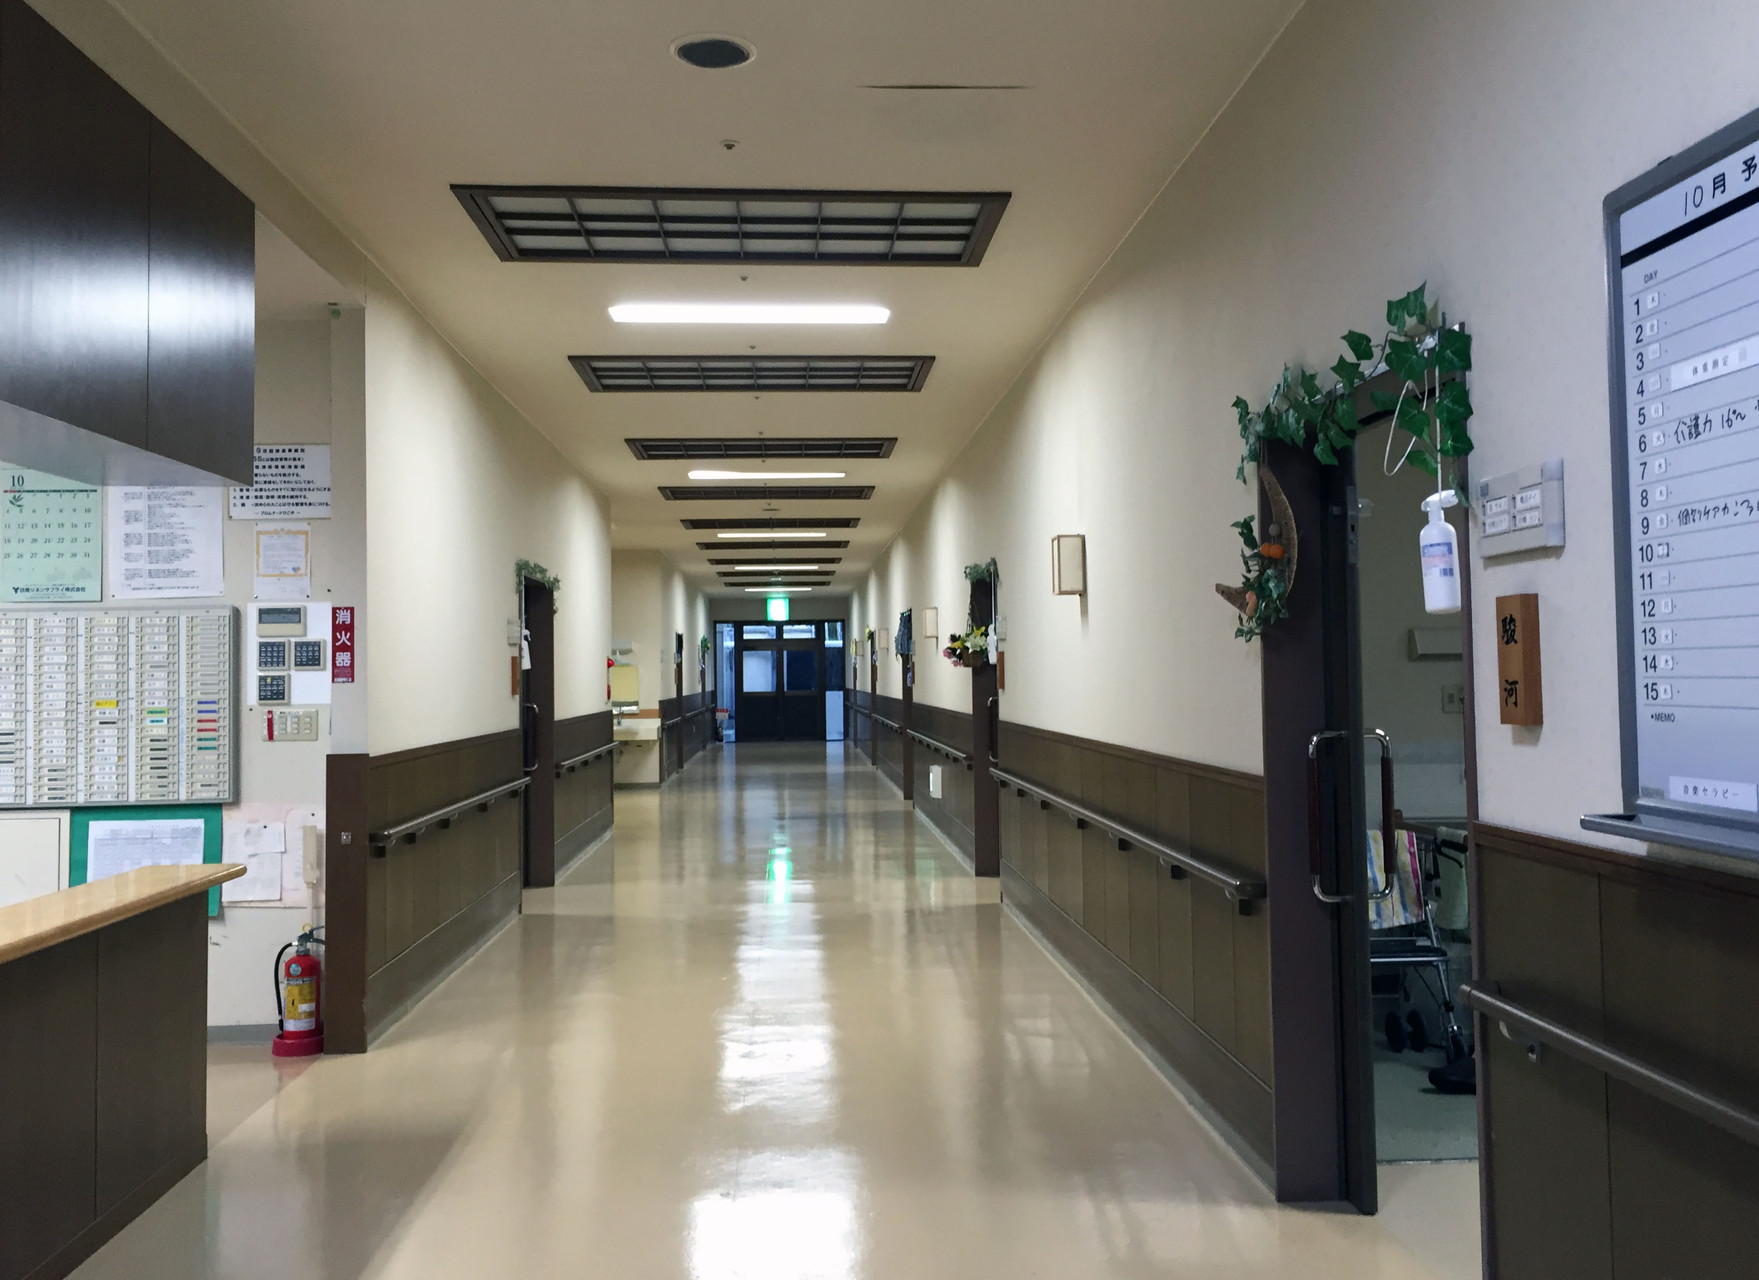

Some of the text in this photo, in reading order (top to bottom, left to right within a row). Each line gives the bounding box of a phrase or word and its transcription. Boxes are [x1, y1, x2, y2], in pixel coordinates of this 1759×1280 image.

[1644, 270, 1658, 284] DAY
[1634, 298, 1640, 316] 1
[1635, 324, 1644, 344] 2
[1636, 352, 1644, 370] 3
[1636, 379, 1645, 397] 4
[1638, 406, 1646, 426] 5
[1638, 434, 1647, 453] 6
[1640, 461, 1648, 480] 7
[12, 475, 24, 487] 10
[1640, 489, 1648, 508] 8
[1641, 516, 1650, 535] 9
[1639, 544, 1654, 563] 10
[1640, 571, 1652, 590] 11
[1641, 598, 1656, 618] 12
[336, 610, 351, 667] 消火器
[1642, 626, 1656, 646] 13
[1643, 654, 1658, 673] 14
[1644, 682, 1658, 700] 15
